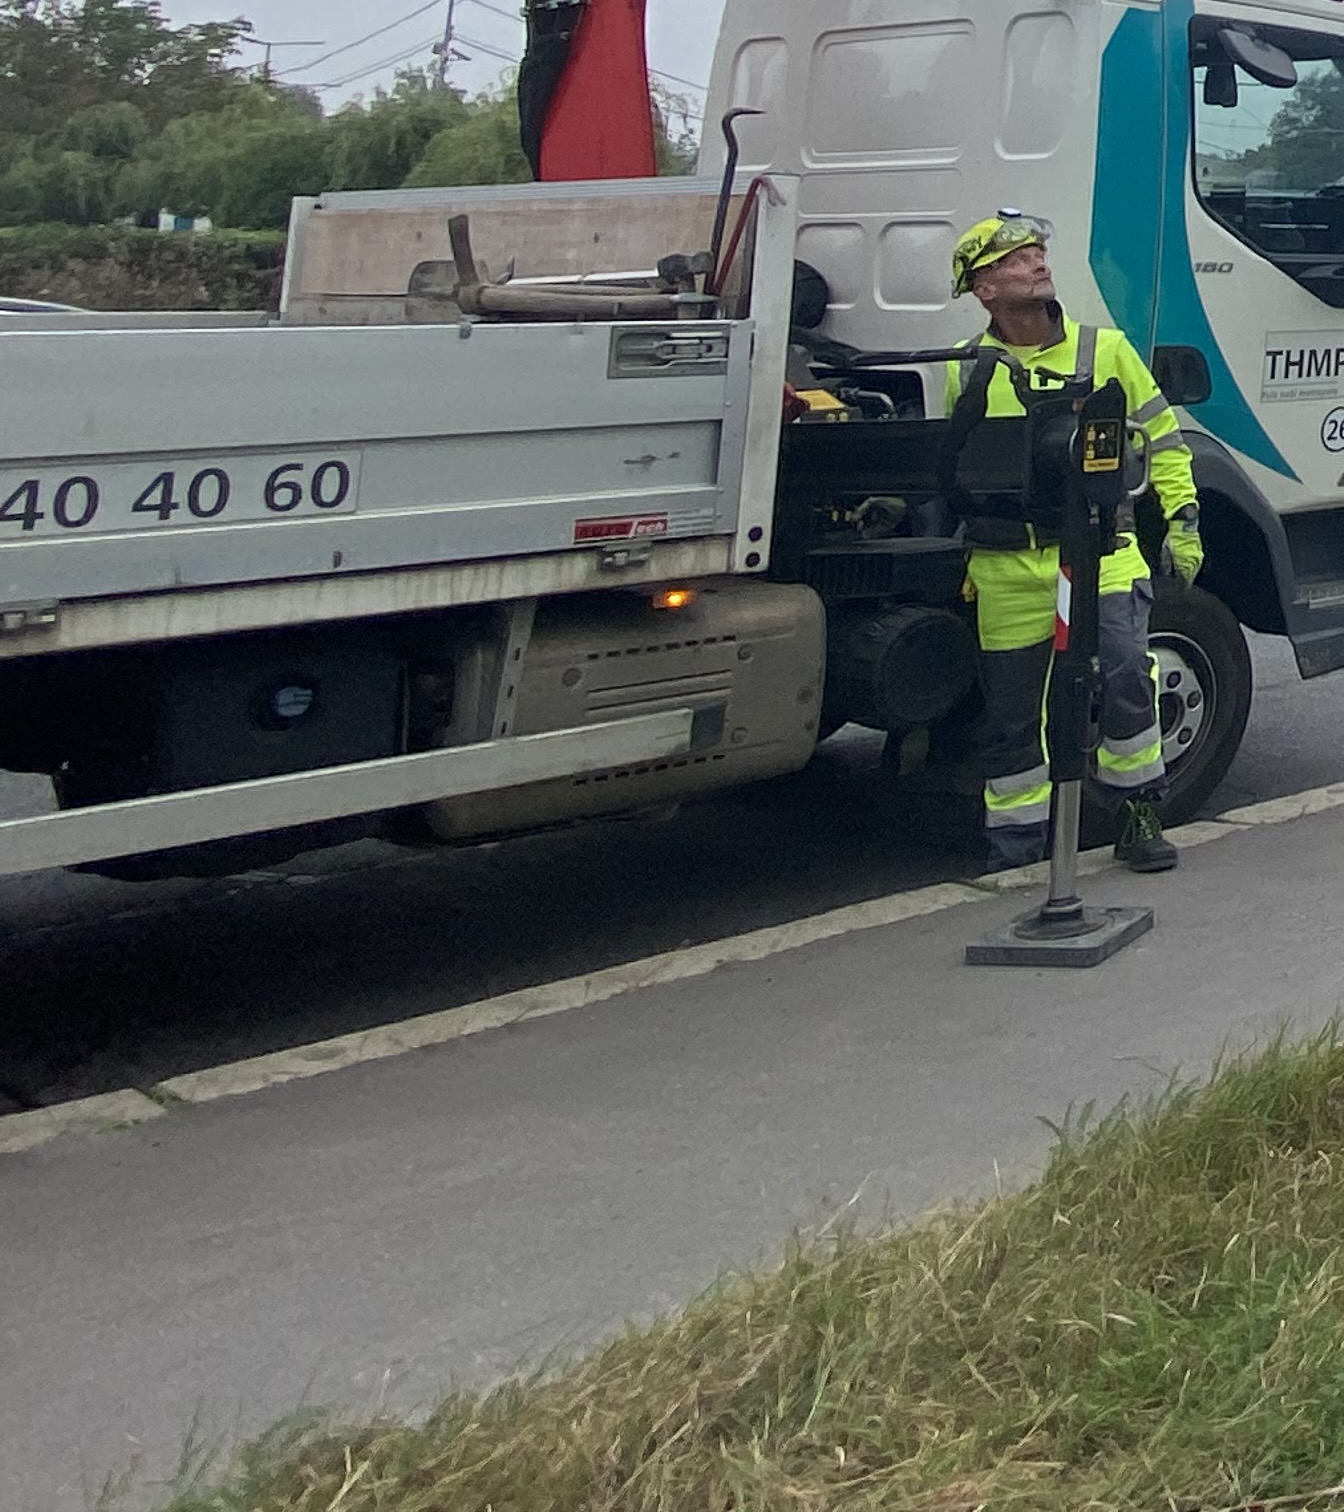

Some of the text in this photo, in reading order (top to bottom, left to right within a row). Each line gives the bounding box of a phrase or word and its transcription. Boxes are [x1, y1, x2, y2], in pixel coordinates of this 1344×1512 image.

[0, 460, 351, 532] 40 40 60
